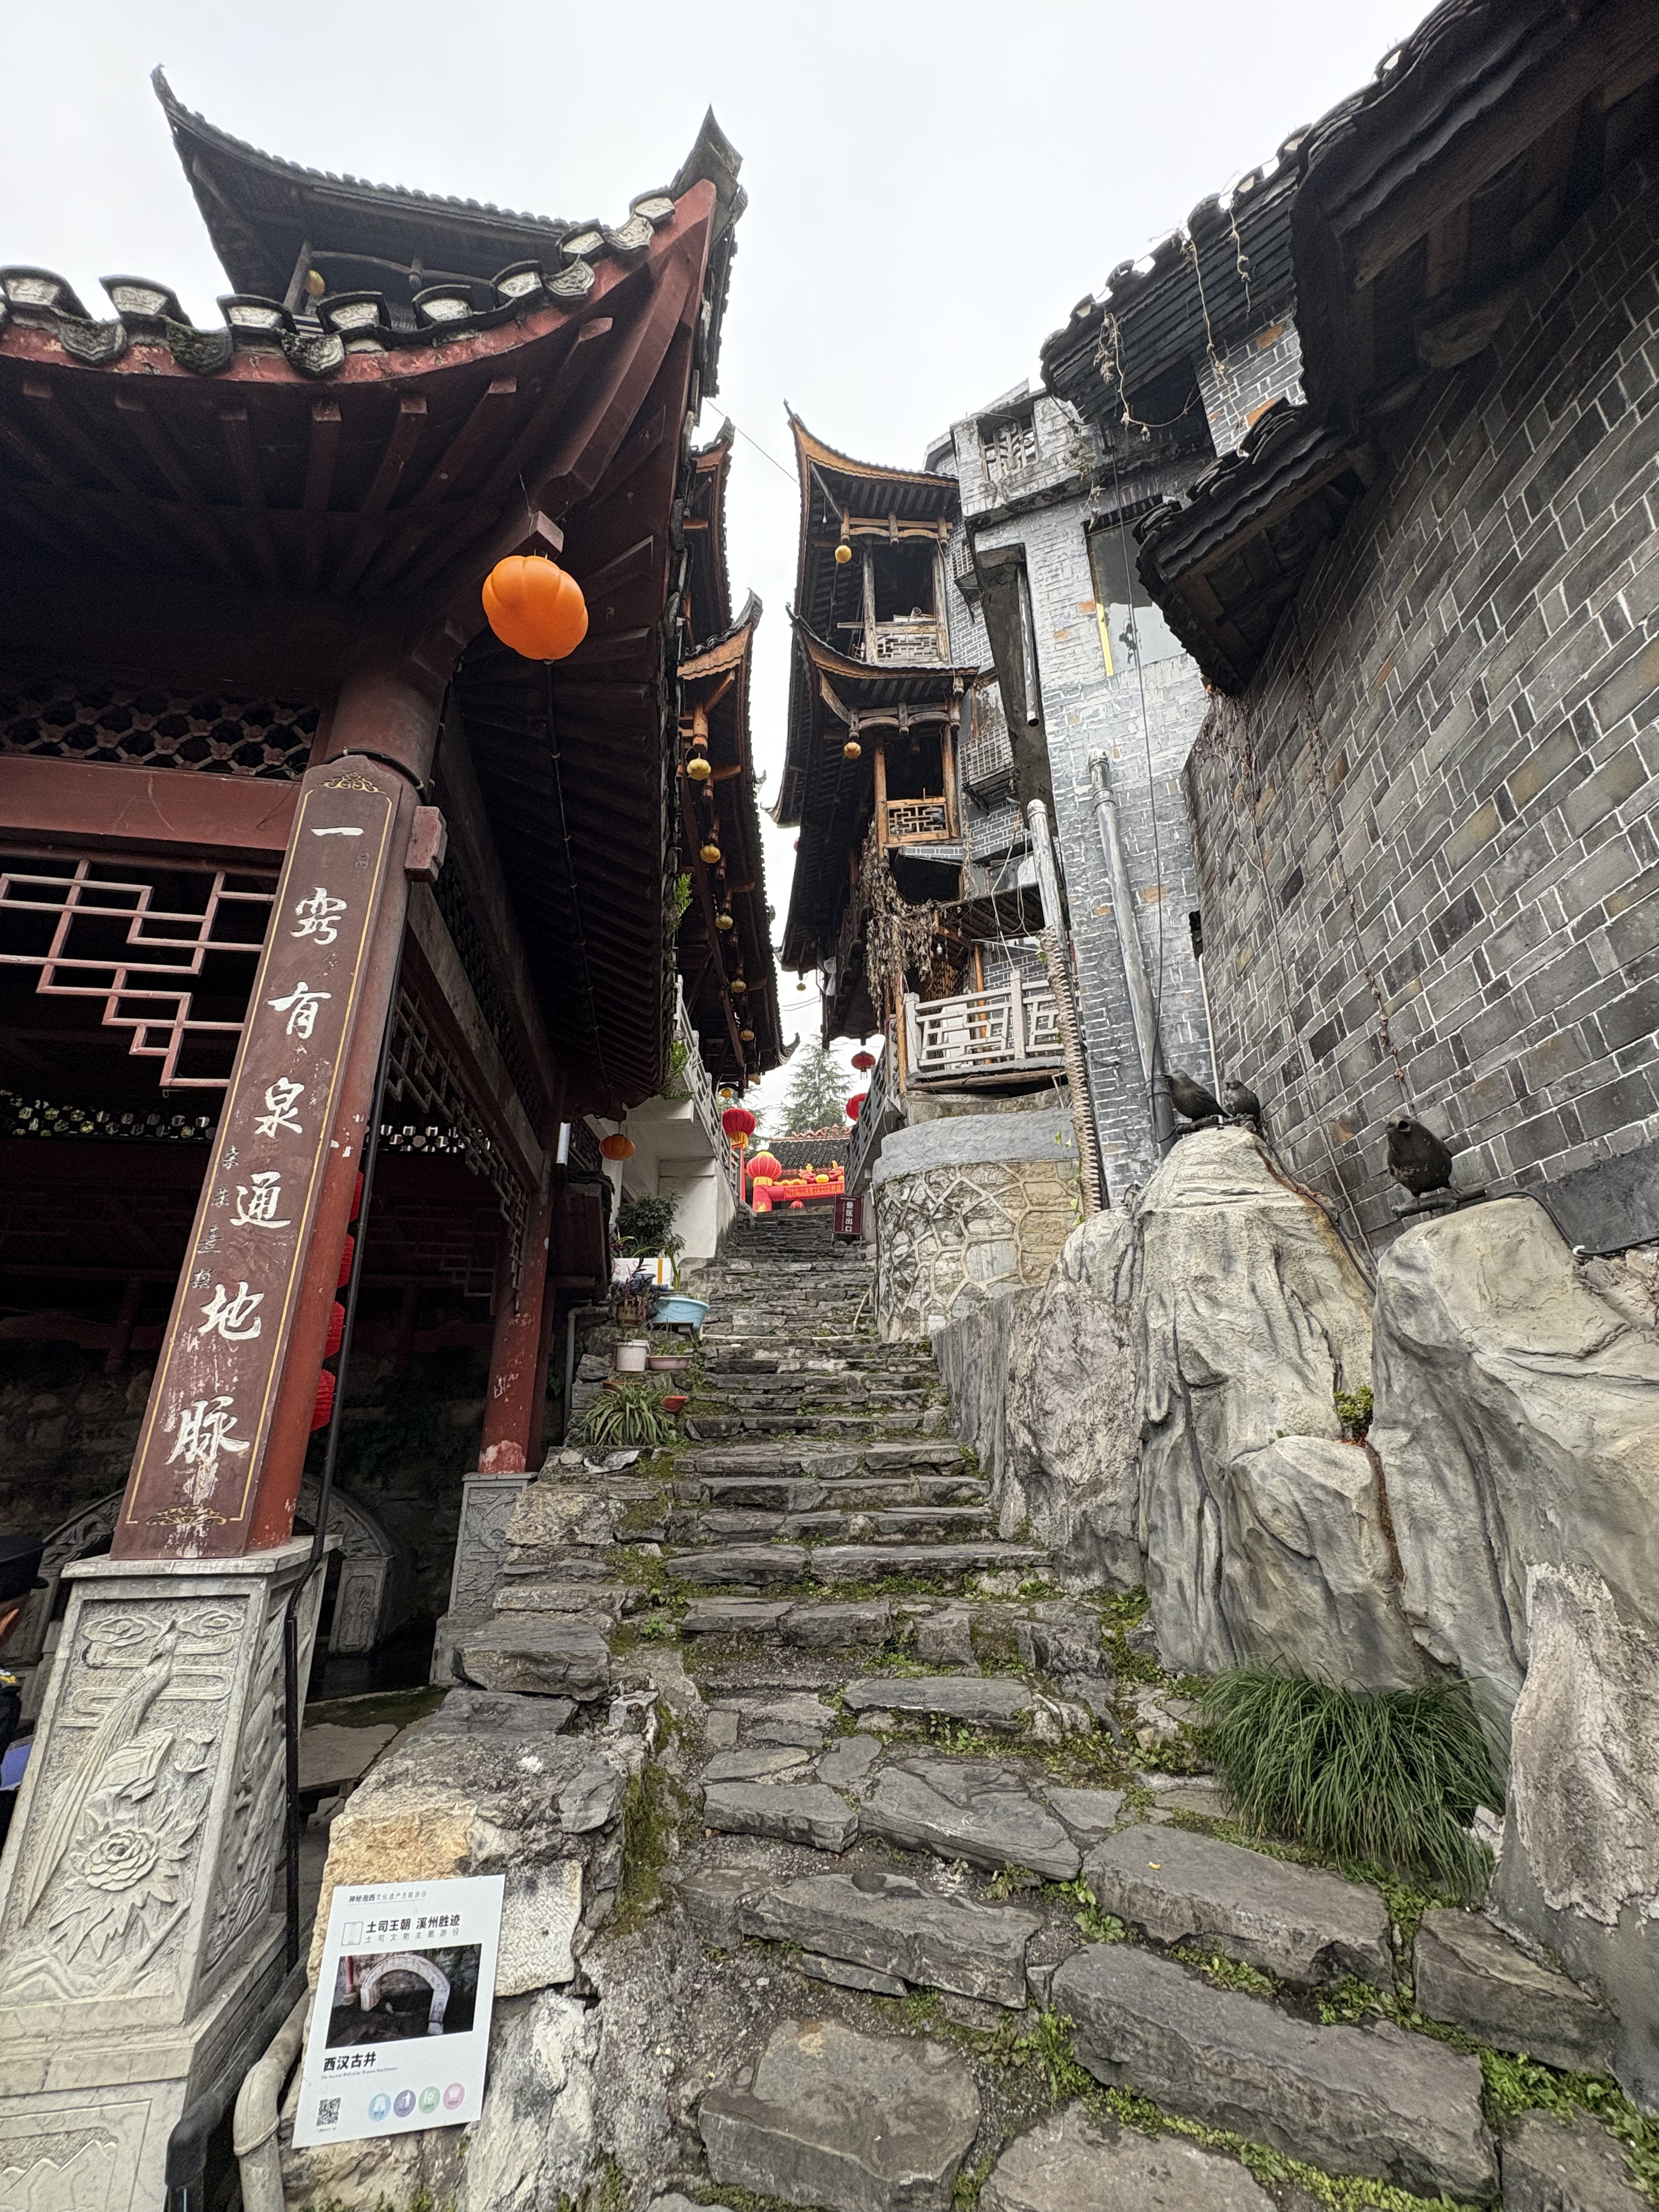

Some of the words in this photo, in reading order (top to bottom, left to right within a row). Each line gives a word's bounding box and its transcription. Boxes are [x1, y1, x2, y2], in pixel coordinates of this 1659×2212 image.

[845, 1202, 854, 1232] 景区出口
[366, 1918, 411, 1933] 土司王朝
[416, 1914, 461, 1929] 溪州胜迹
[364, 1927, 460, 1944] 土司文物主题游径
[324, 2052, 376, 2072] 西汉古井
